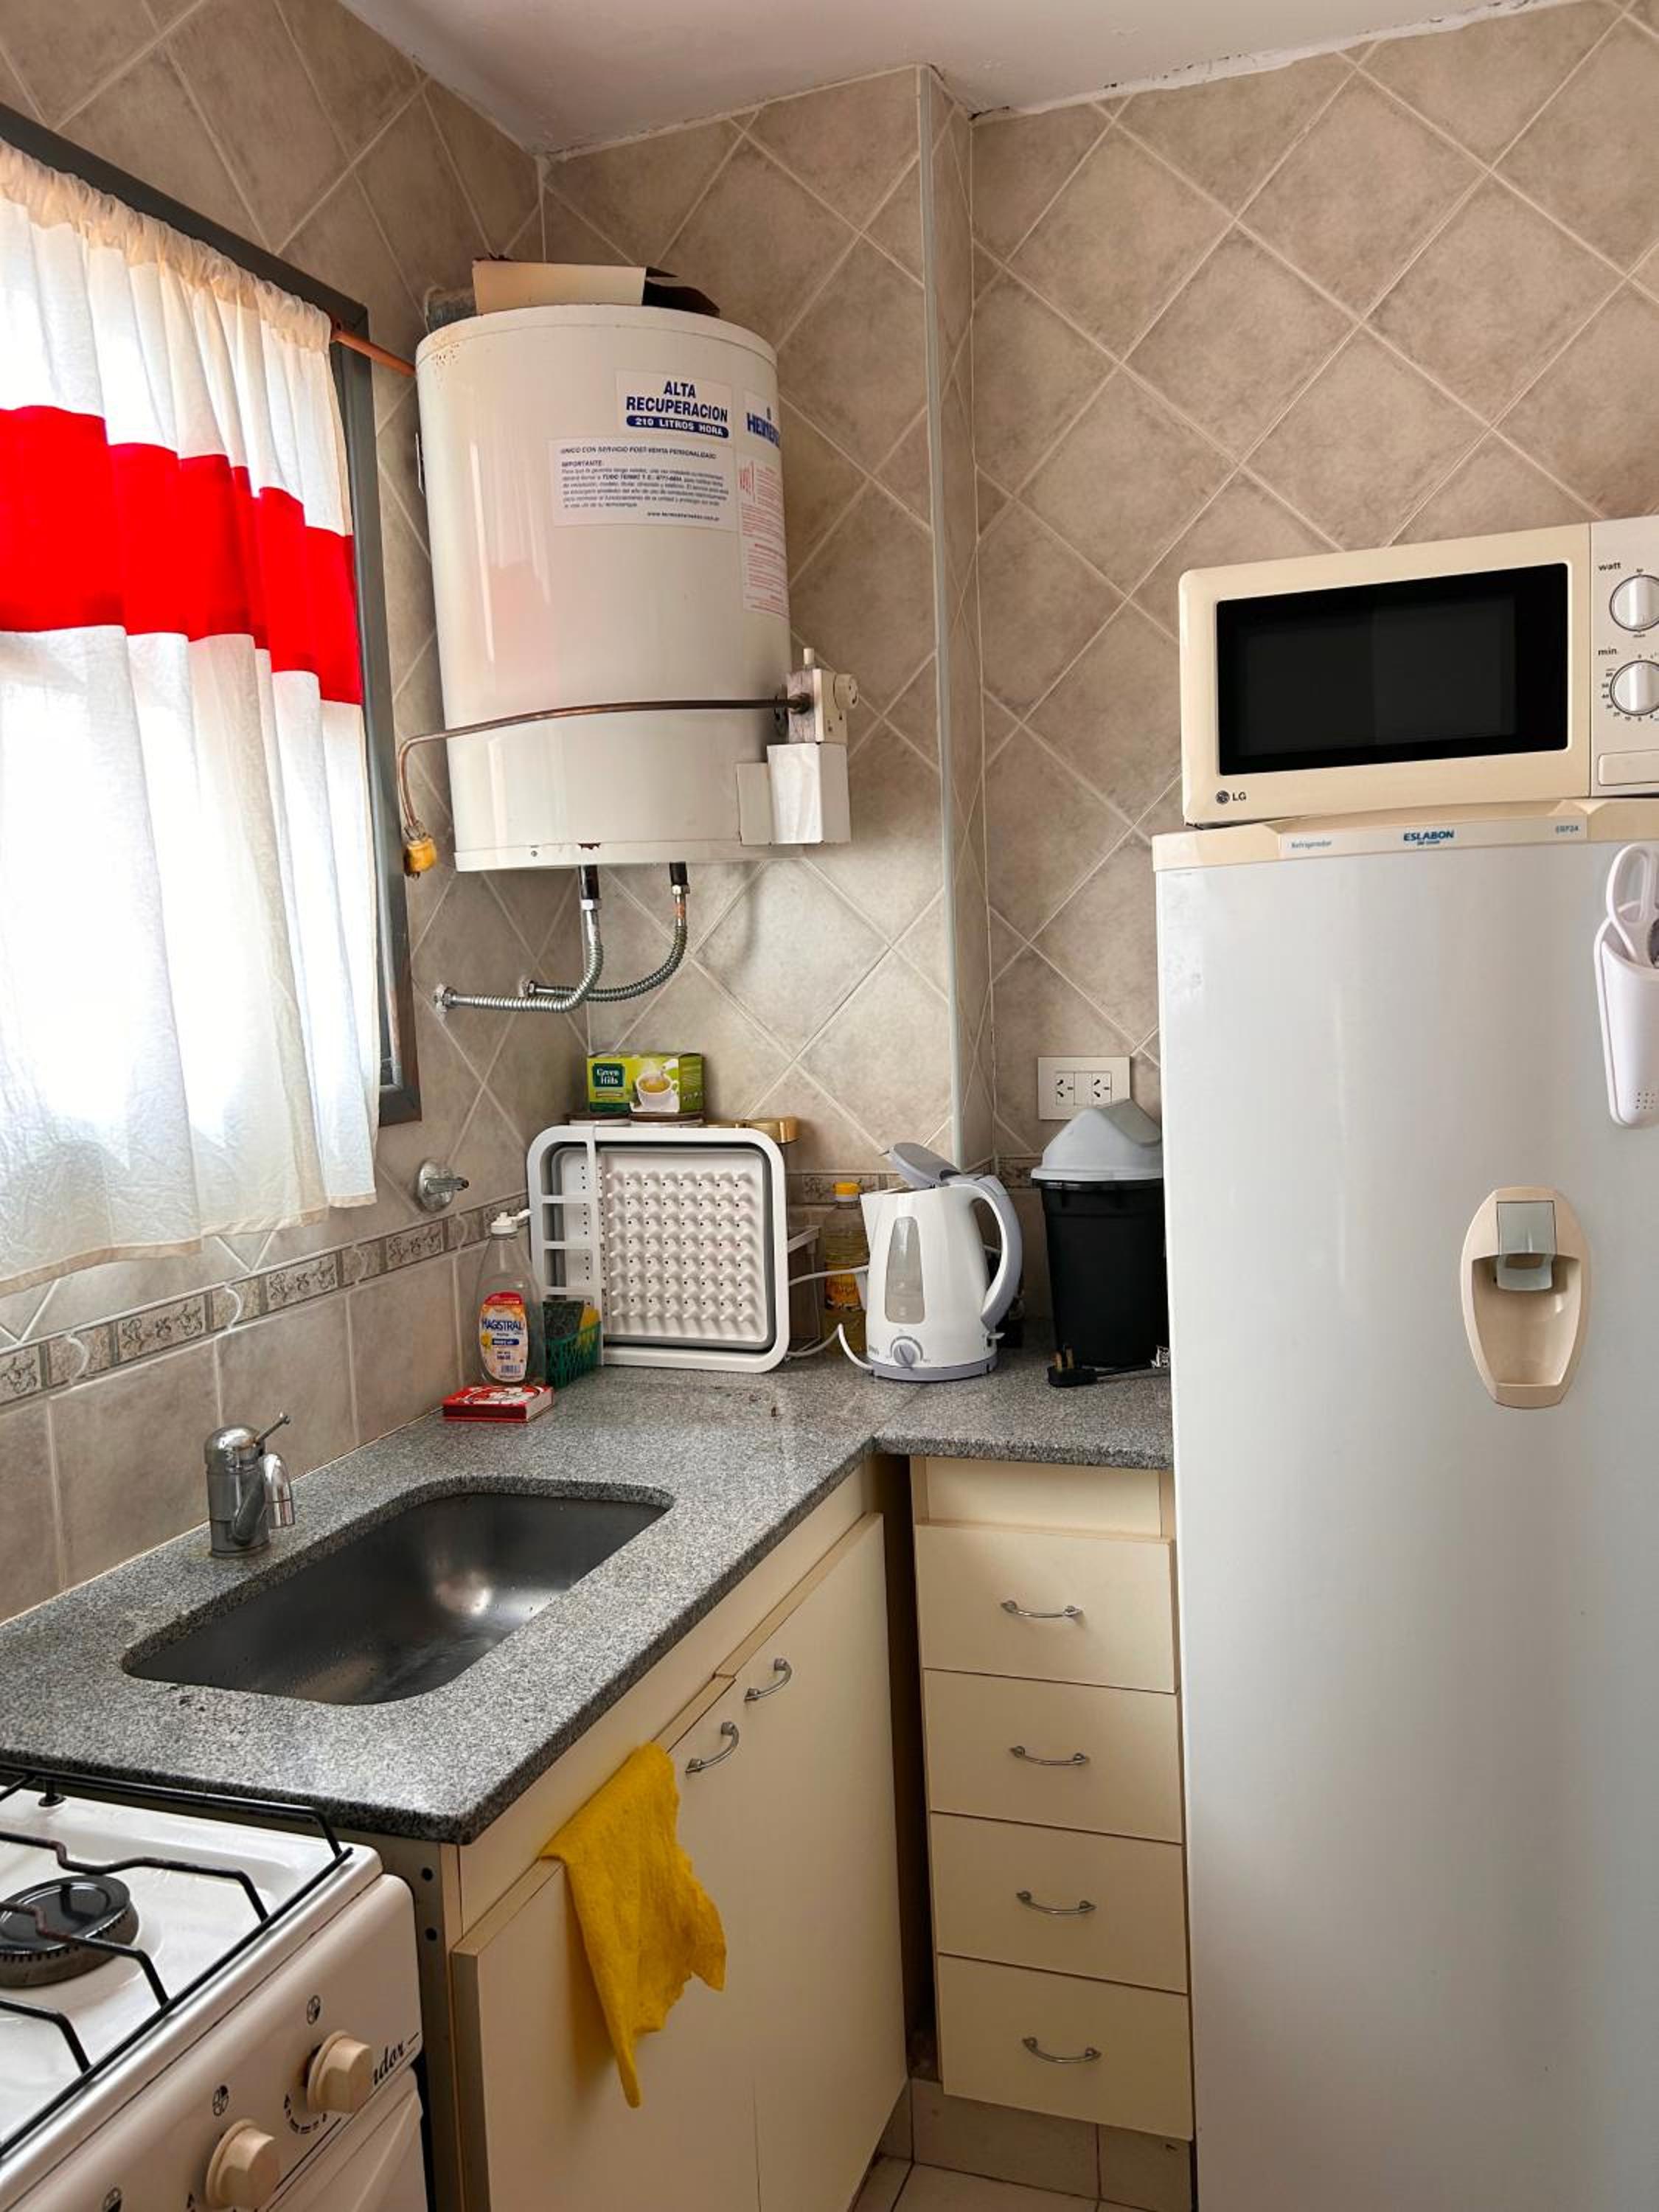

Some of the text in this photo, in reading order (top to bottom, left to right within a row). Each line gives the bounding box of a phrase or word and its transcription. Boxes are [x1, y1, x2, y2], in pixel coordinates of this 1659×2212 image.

[664, 380, 697, 399] ALTA
[626, 396, 728, 423] RECUPERACION
[636, 417, 723, 437] 210 LITROS HORA
[1598, 562, 1621, 571] watt
[1232, 791, 1247, 801] LG
[1403, 829, 1454, 841] ESLABON
[601, 1074, 619, 1085] Hills
[482, 1317, 525, 1332] MAGISTRAL
